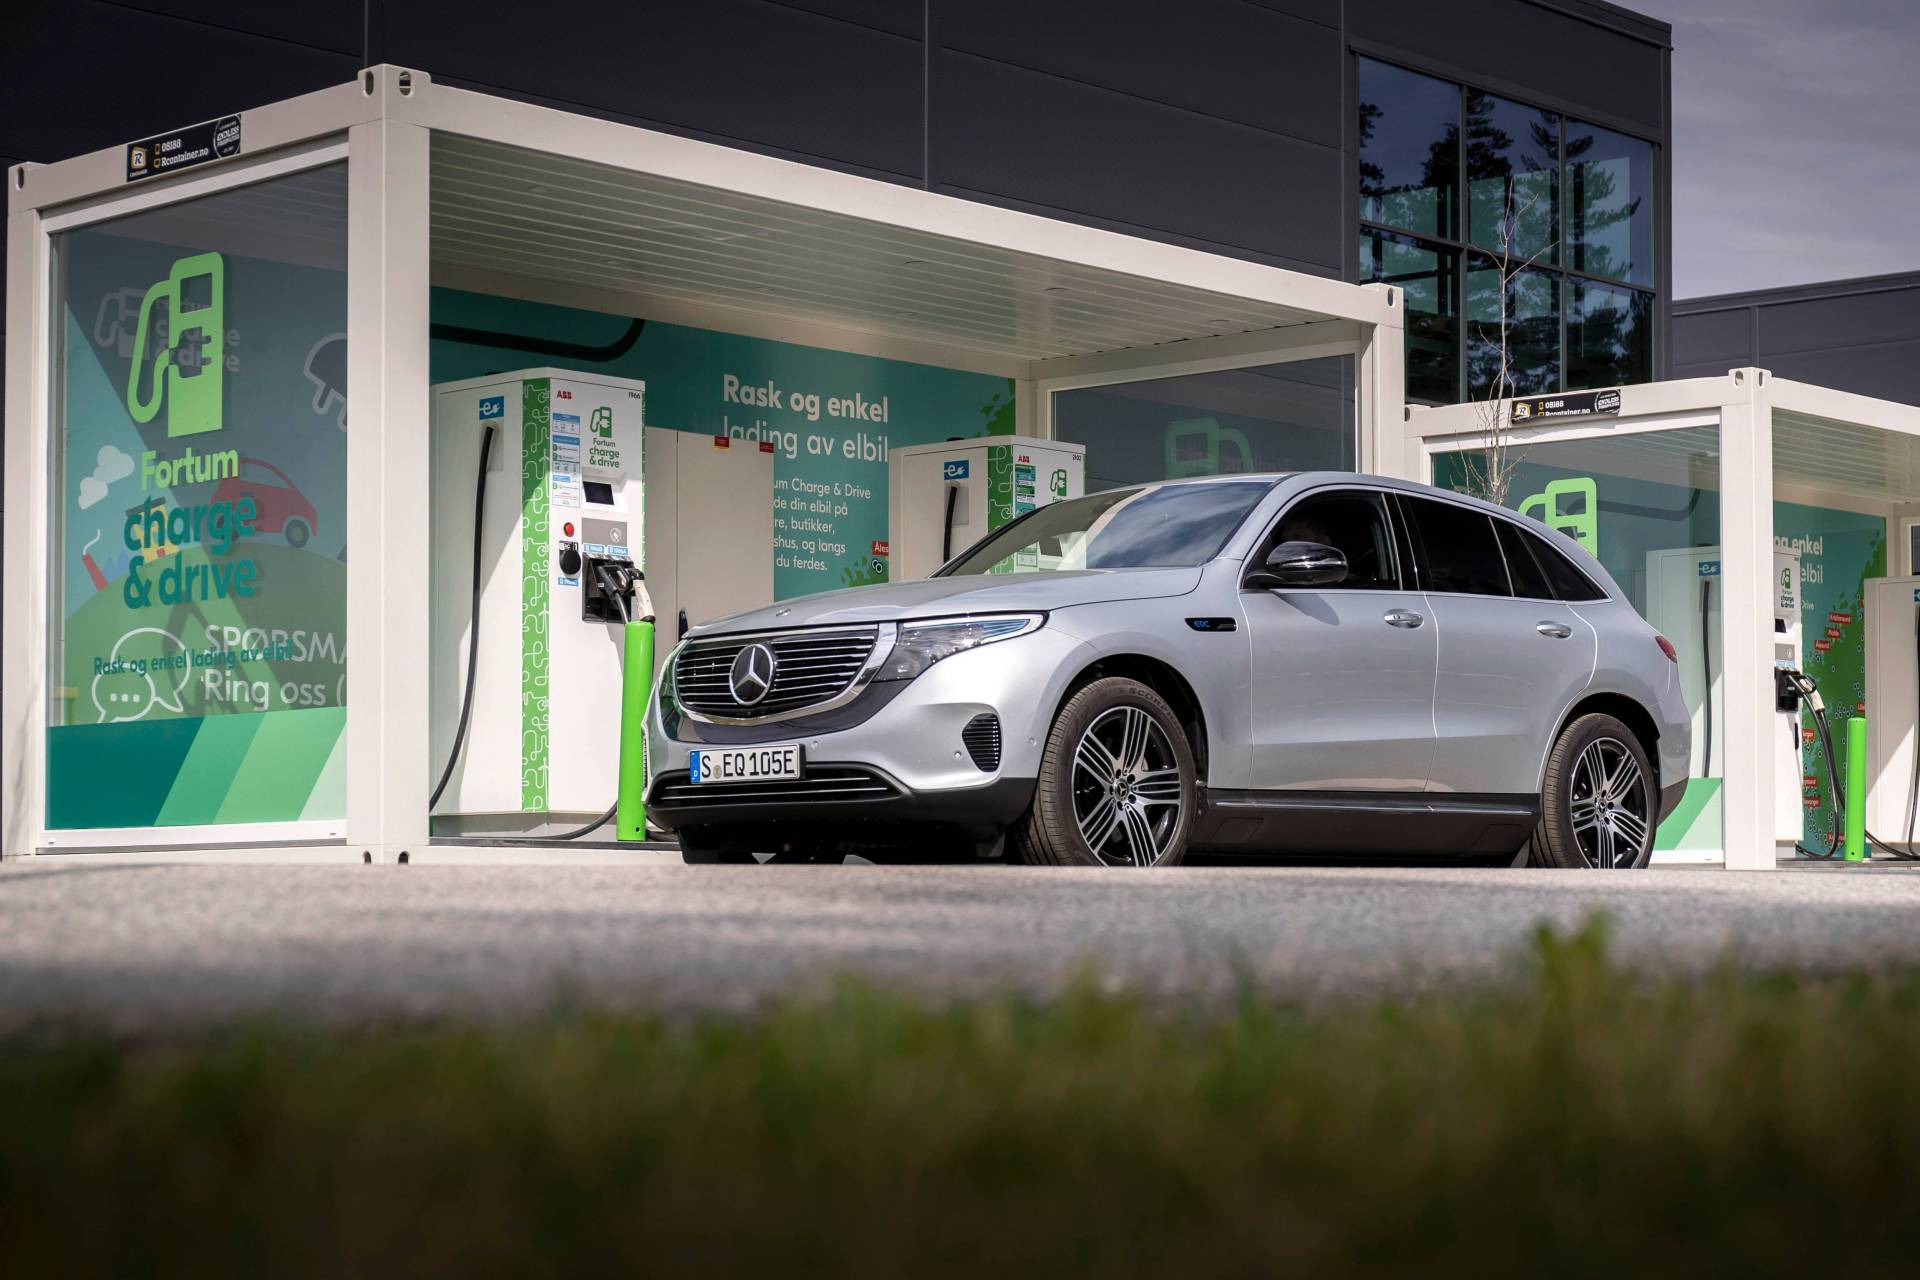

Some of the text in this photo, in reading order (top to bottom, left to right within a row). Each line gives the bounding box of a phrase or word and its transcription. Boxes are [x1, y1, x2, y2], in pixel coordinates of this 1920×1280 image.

[162, 138, 182, 152] 08188
[162, 148, 208, 167] Rcontainer.no
[556, 390, 572, 400] ABB
[723, 374, 888, 423] Rask og enkel
[590, 446, 620, 460] charge
[592, 438, 616, 448] Fortum
[806, 434, 834, 456] av
[843, 432, 888, 462] elbil
[141, 448, 238, 490] Fortum
[590, 456, 620, 468] & drive
[1018, 455, 1030, 463] ABB
[792, 478, 830, 496] Charge
[834, 483, 841, 496] &
[845, 484, 871, 499] Drive
[790, 498, 806, 510] din
[810, 500, 831, 513] elbil
[835, 502, 848, 517] på
[124, 496, 256, 556] charge
[792, 517, 835, 535] butikker,
[802, 540, 815, 554] og
[819, 540, 846, 556] langs
[1792, 534, 1822, 556] enkel
[776, 555, 827, 570] du ferdes.
[124, 551, 256, 609] & drive
[1800, 563, 1823, 584] elbil
[206, 624, 347, 664] SPØRSM
[94, 655, 125, 676] Rask
[130, 658, 146, 676] og
[151, 649, 187, 671] enkel
[241, 649, 258, 662] av
[204, 668, 326, 712] Ring oss
[702, 755, 711, 778] S
